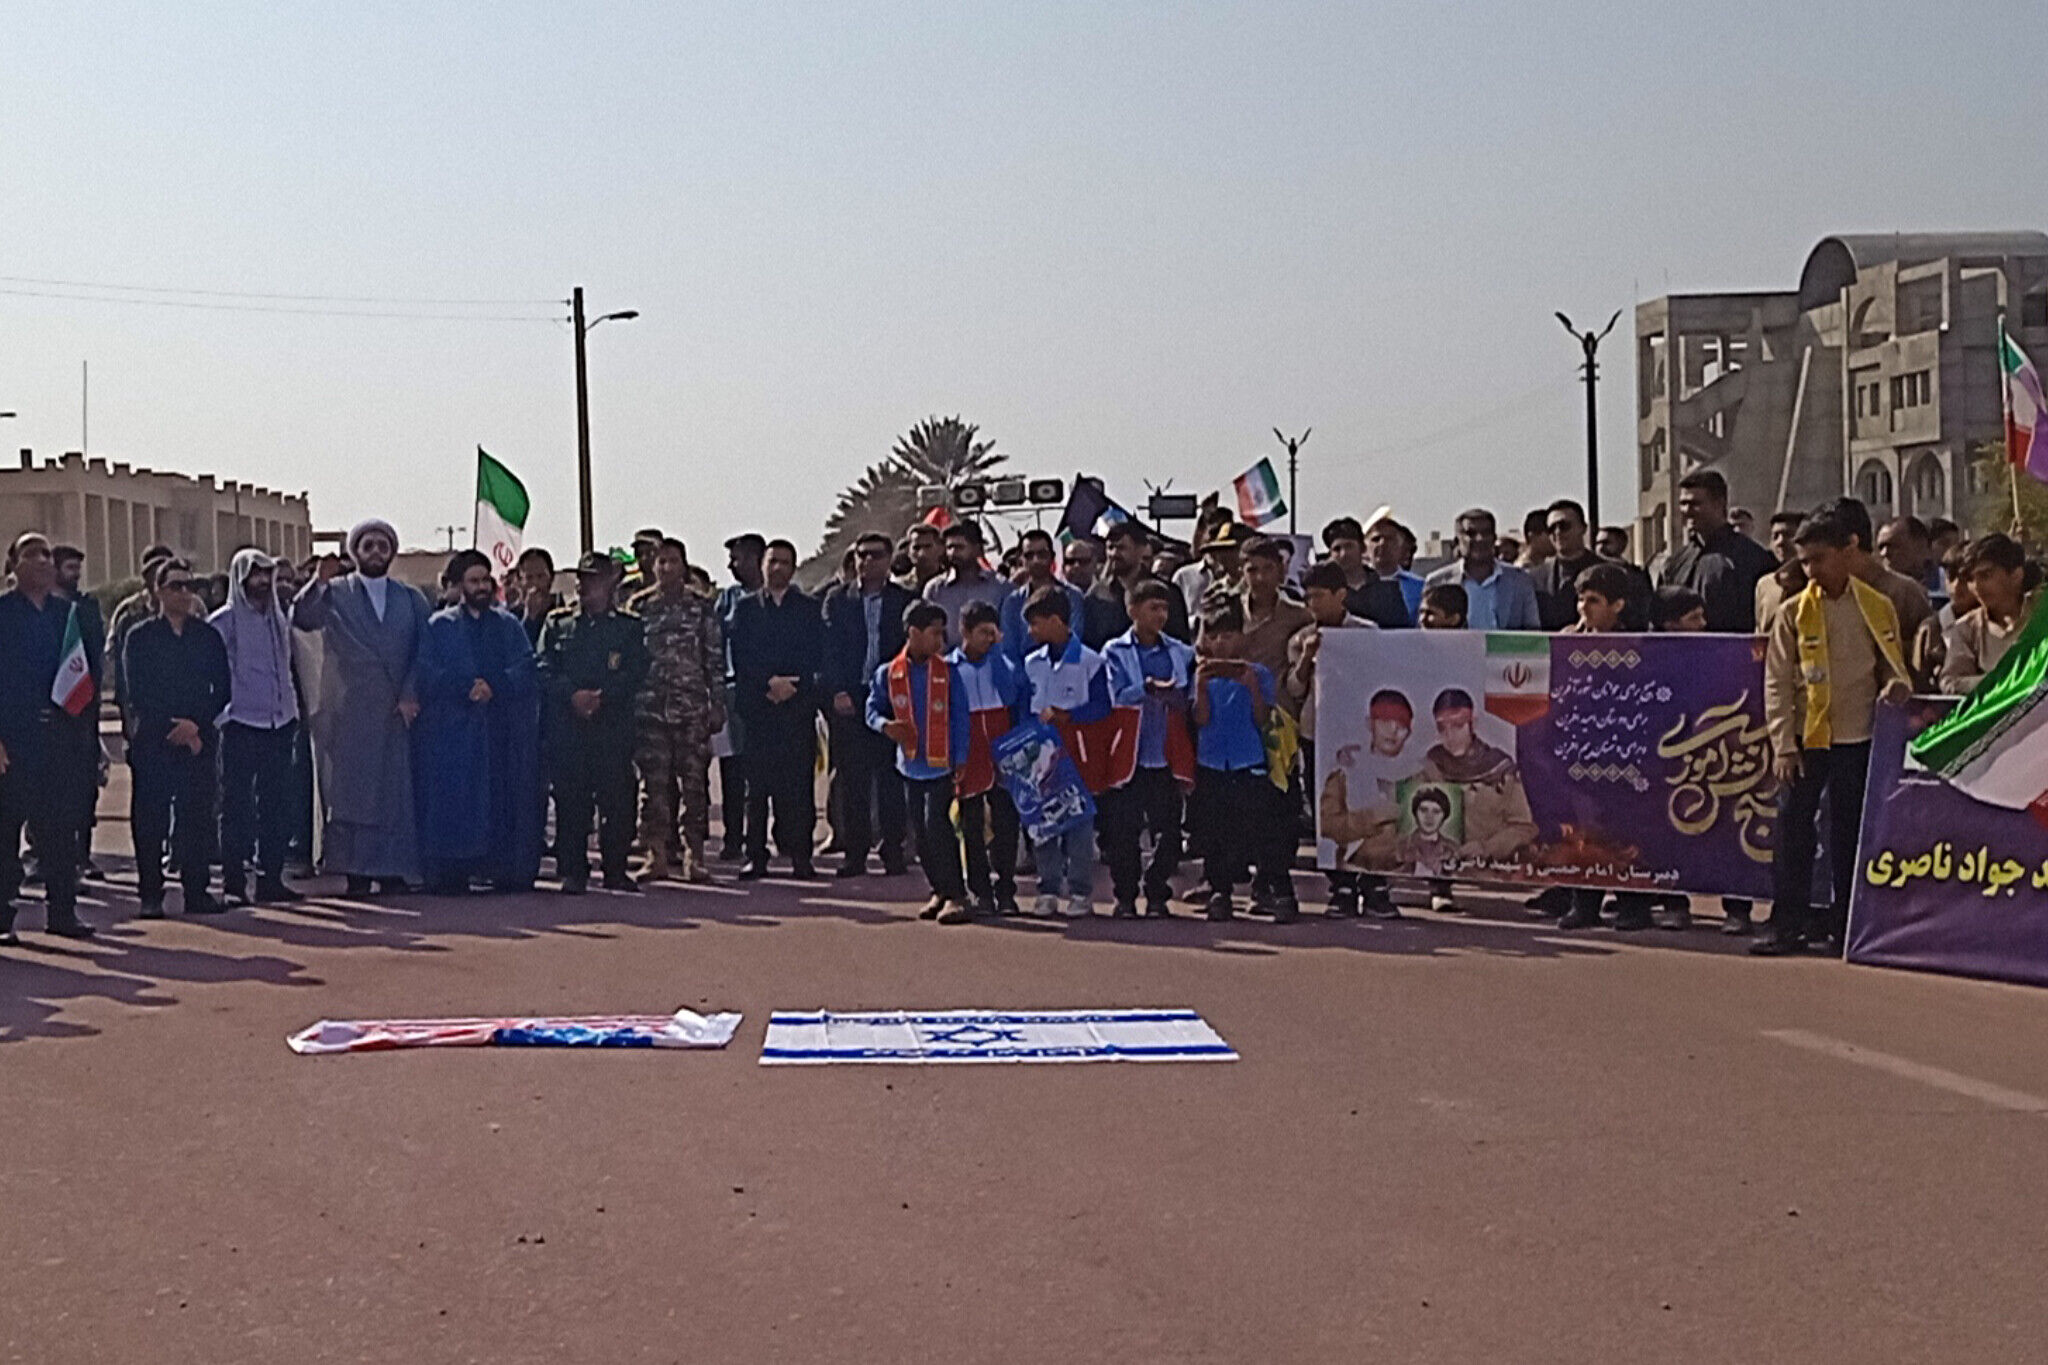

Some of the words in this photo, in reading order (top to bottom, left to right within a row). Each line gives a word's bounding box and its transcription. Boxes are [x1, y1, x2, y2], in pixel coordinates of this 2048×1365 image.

[1443, 855, 1486, 872] ناصری
[1489, 852, 1521, 872] شهید
[1526, 862, 1534, 877] و
[1585, 862, 1613, 879] امام
[1866, 842, 1952, 888] ناصری
[1957, 845, 2026, 897] جواد
[1617, 863, 1680, 883] دبیرستان
